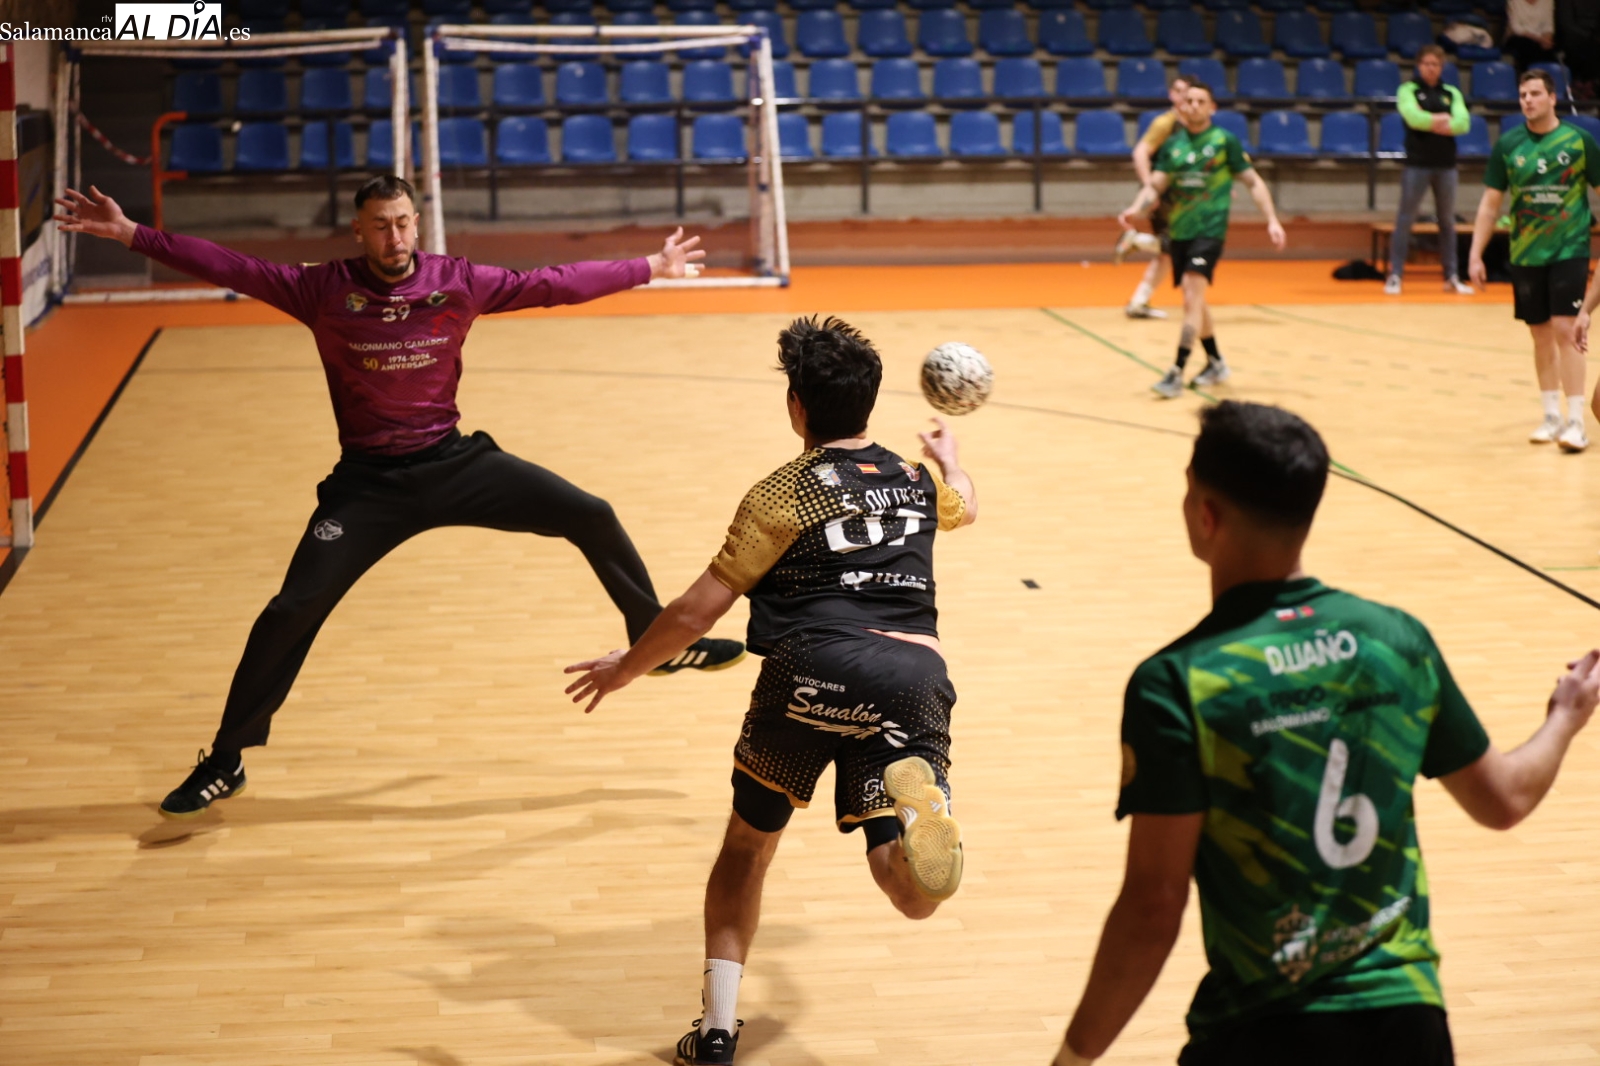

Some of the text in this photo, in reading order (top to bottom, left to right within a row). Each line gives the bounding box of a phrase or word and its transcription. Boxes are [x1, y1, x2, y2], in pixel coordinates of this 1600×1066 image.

[1537, 158, 1548, 175] 5
[382, 304, 411, 322] 39
[362, 357, 378, 370] 50
[793, 674, 846, 693] AUTOCARES
[787, 685, 882, 723] Sanalón
[1313, 737, 1380, 870] 6
